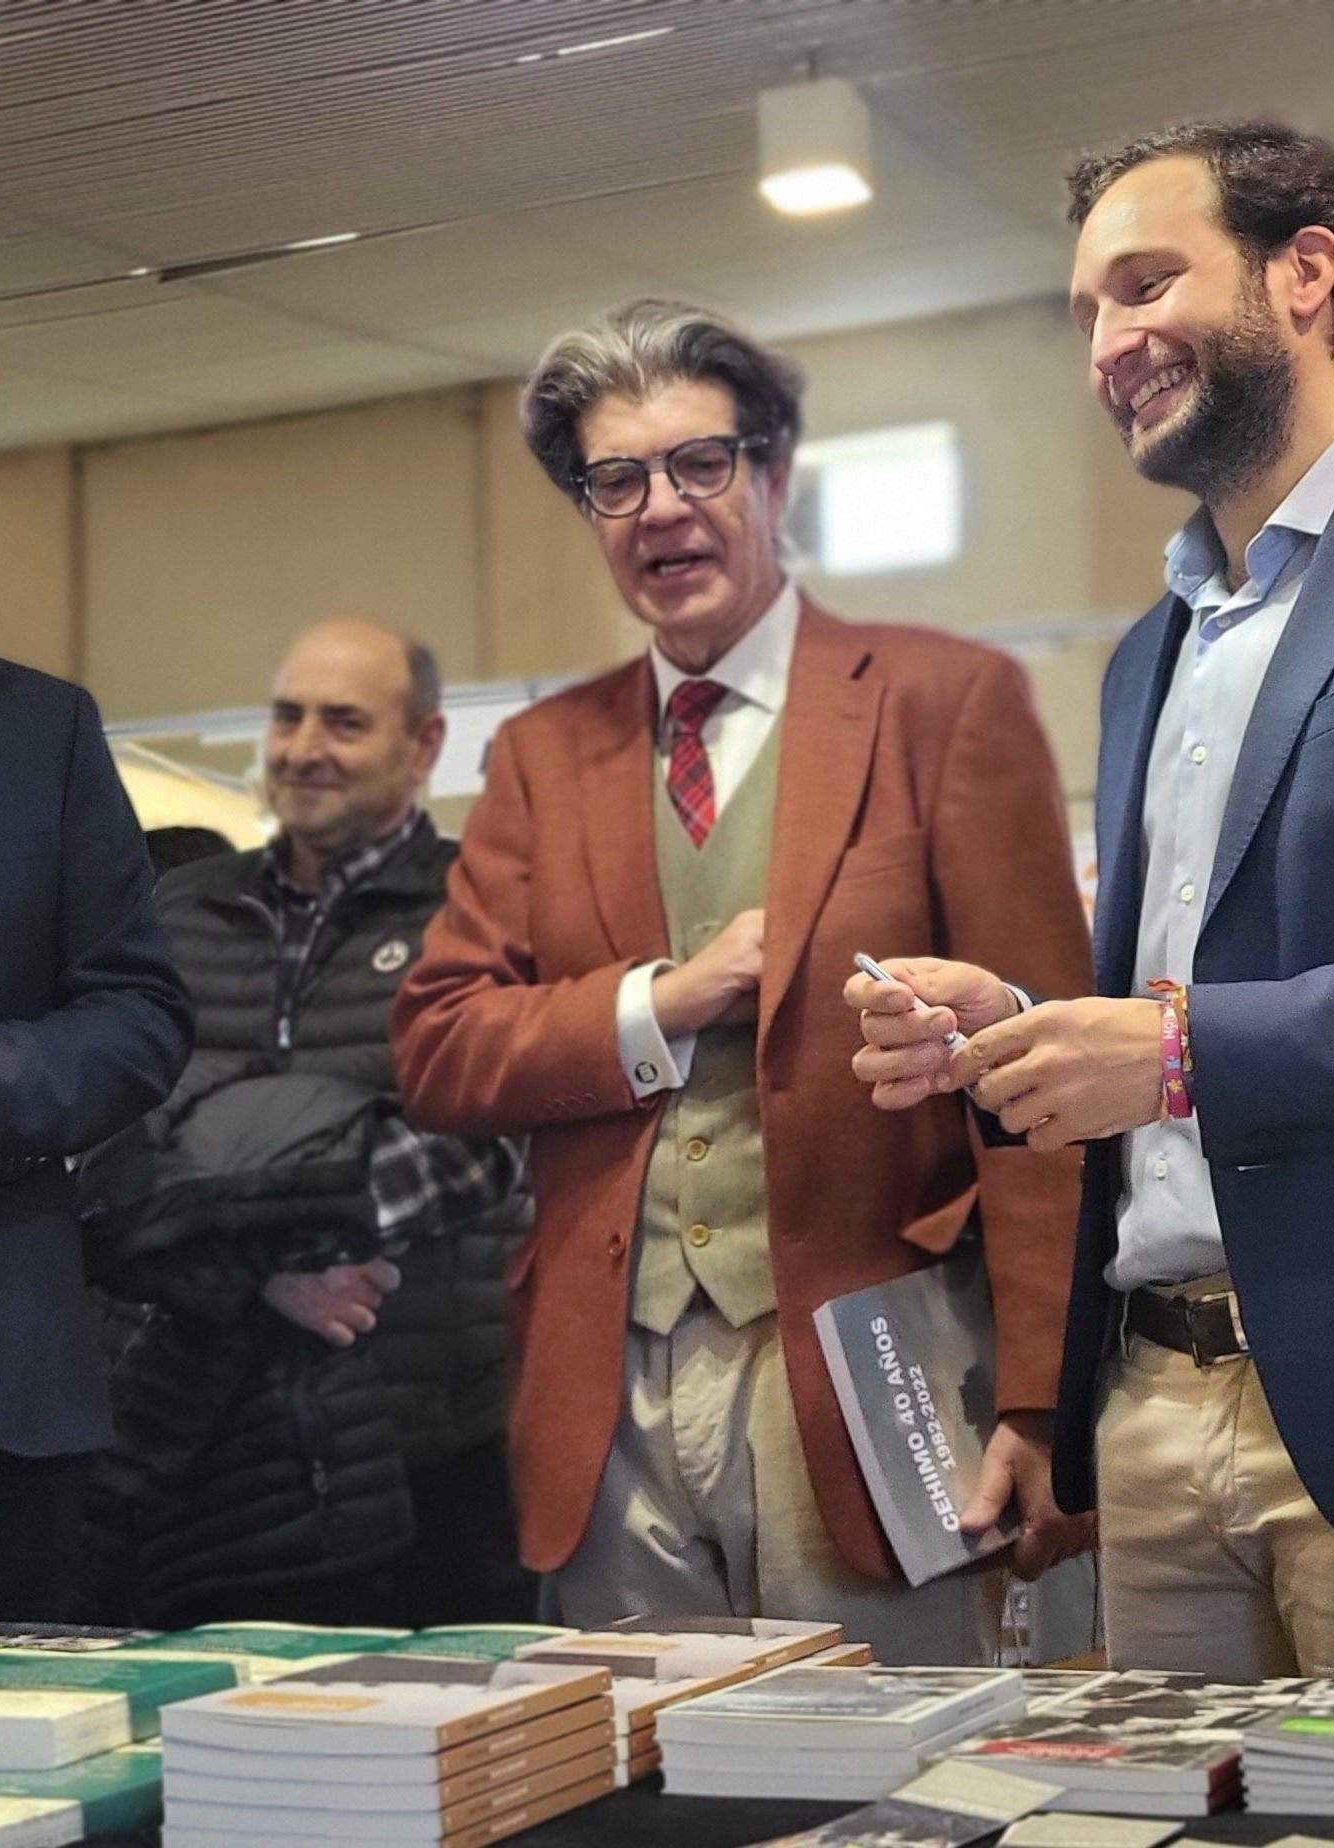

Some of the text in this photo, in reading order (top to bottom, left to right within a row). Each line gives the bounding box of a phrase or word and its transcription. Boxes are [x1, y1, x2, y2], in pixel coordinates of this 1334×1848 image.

[870, 1316, 960, 1532] CEHIMO 40 AÑOS
[909, 1364, 957, 1470] 1982-2022
